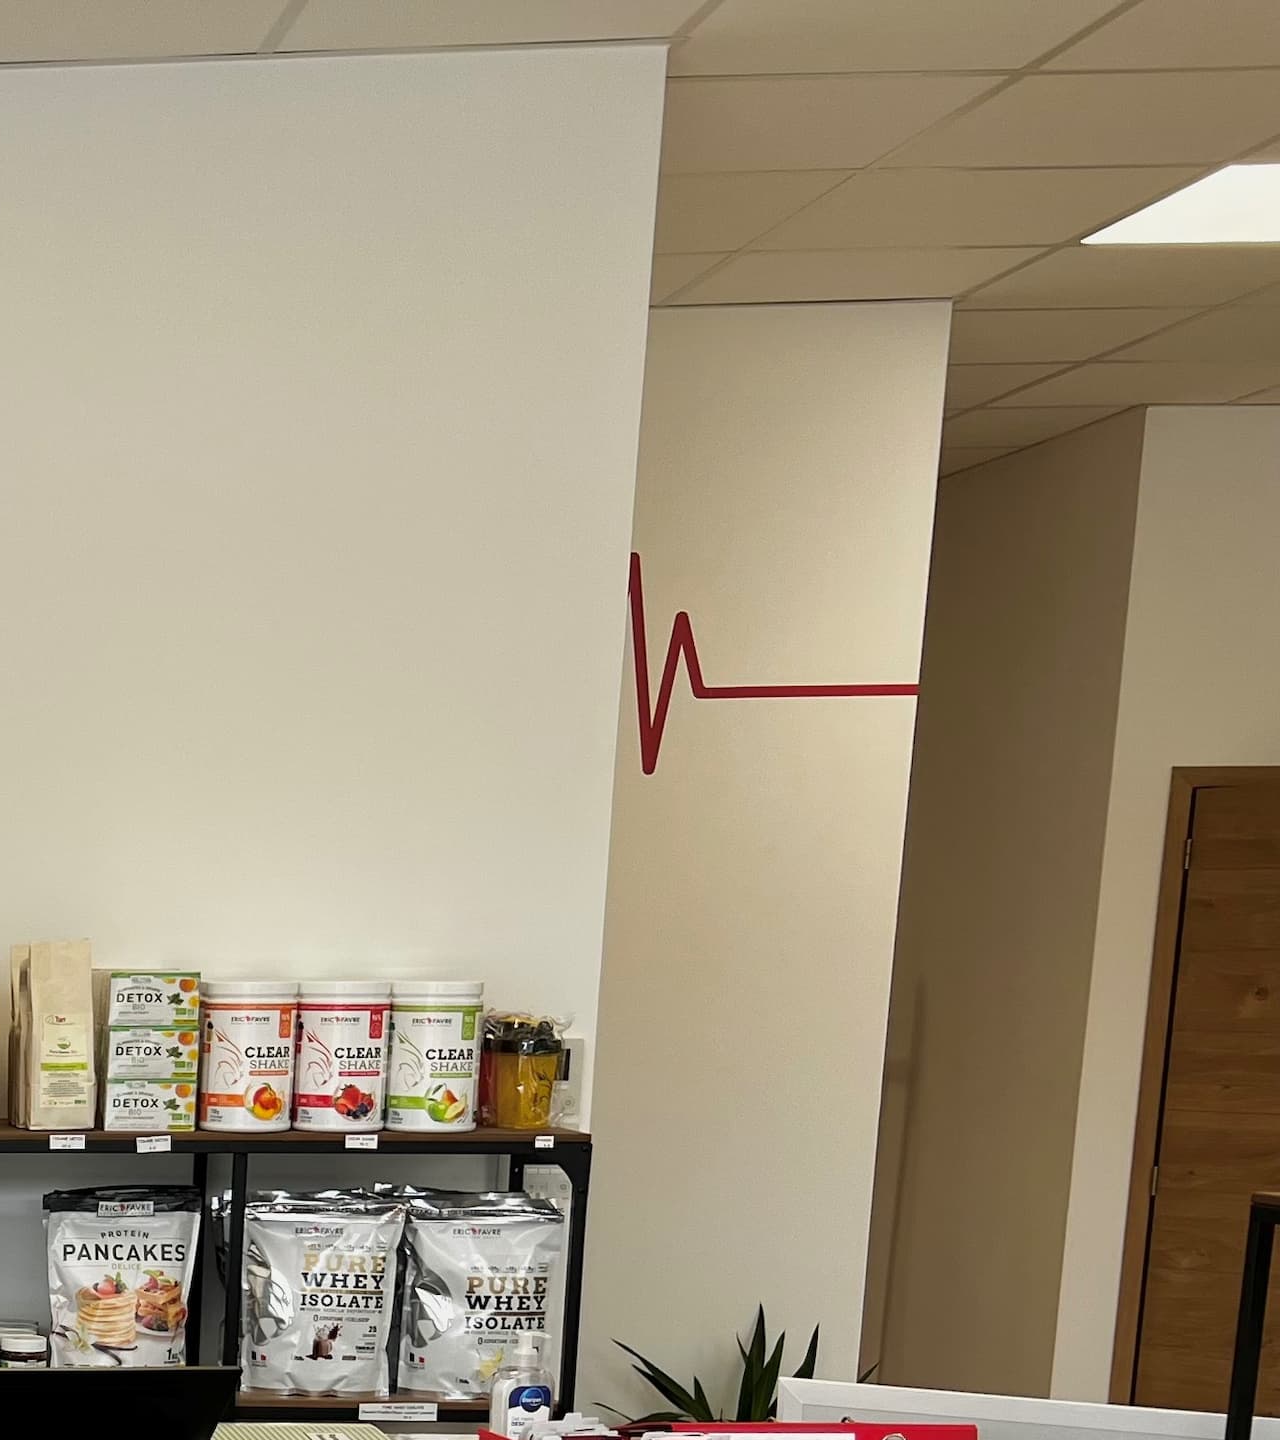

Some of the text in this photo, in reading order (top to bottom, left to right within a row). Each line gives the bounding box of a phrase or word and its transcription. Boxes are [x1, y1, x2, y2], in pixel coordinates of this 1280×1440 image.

[116, 993, 163, 1003] DETOX
[115, 1047, 162, 1056] DETOX
[245, 1047, 290, 1058] CLEAR
[334, 1047, 381, 1059] CLEAR
[425, 1049, 474, 1060] CLEAR
[249, 1060, 289, 1069] SHAKE
[339, 1060, 381, 1069] SHAKE
[431, 1062, 473, 1071] SHAKE
[113, 1098, 159, 1108] DETOX
[100, 1204, 152, 1212] ERIC FAVRE
[100, 1229, 150, 1240] PROTEIN
[63, 1244, 186, 1262] PANCAKES
[303, 1253, 386, 1274] PURE
[301, 1272, 384, 1289] WHEY
[466, 1277, 547, 1294] PURE
[300, 1294, 383, 1309] ISOLATE
[465, 1295, 546, 1310] WHEY
[465, 1316, 545, 1330] ISOLATE
